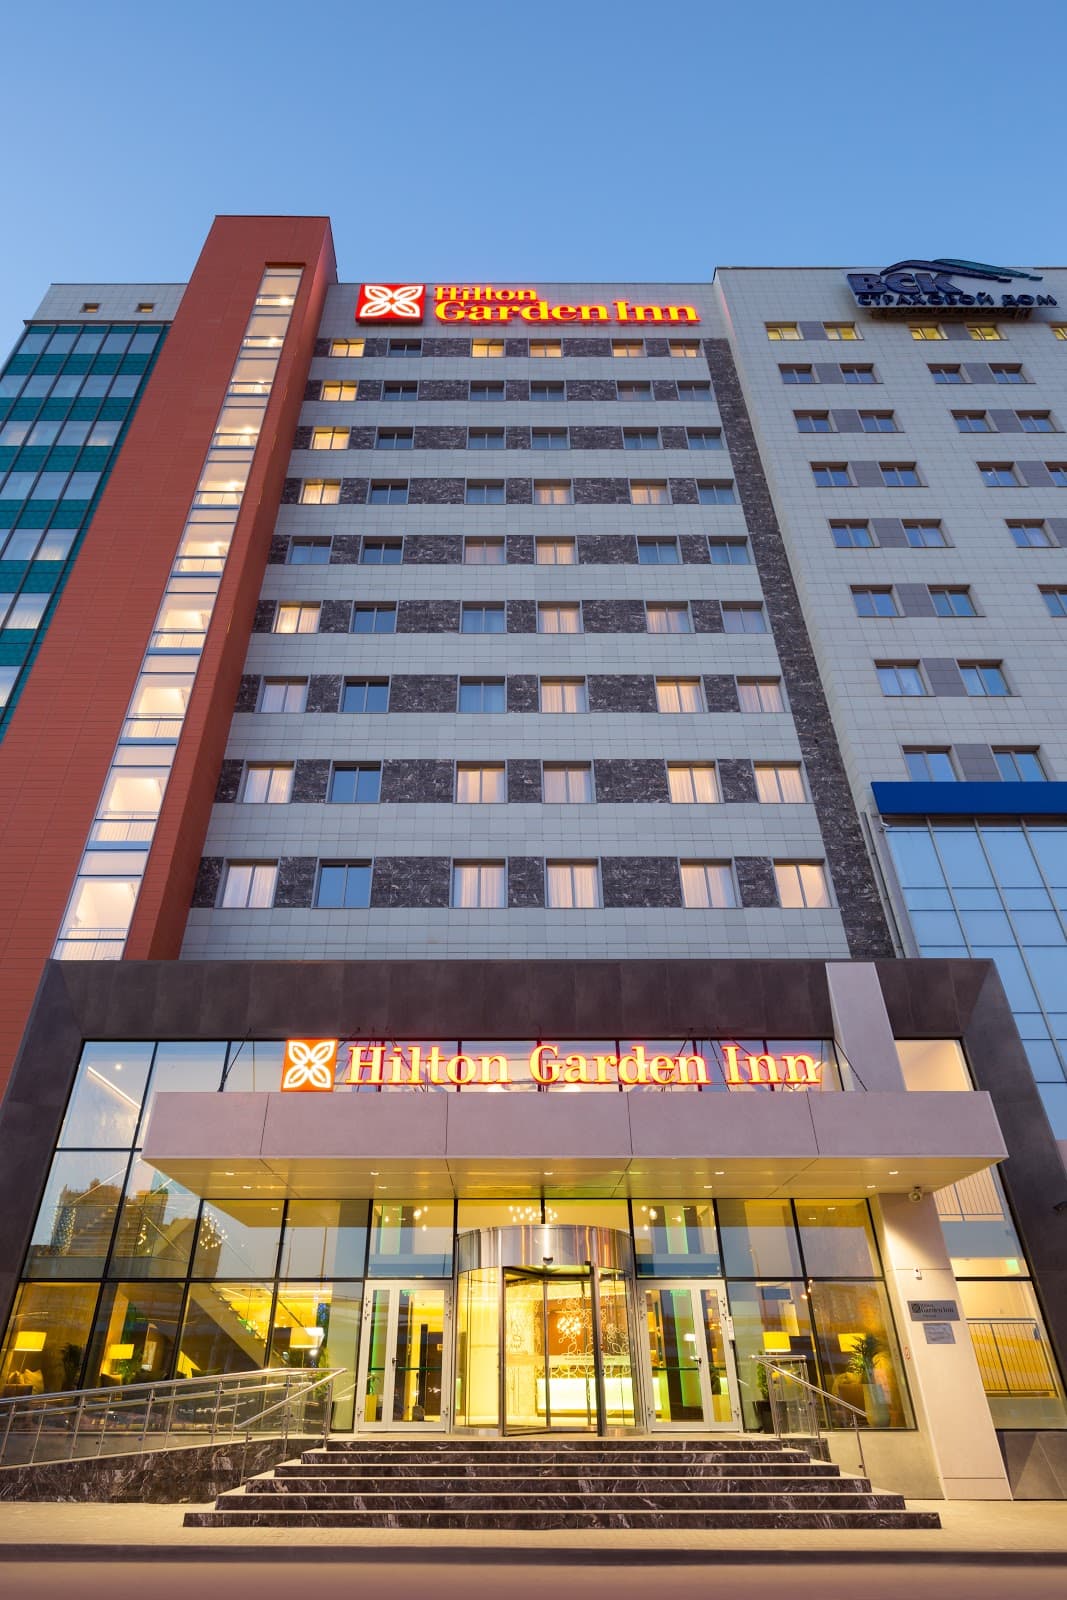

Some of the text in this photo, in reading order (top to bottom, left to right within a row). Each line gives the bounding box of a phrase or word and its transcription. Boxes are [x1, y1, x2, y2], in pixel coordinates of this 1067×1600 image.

[434, 285, 538, 302] Hilton
[847, 273, 963, 295] ВСК
[857, 291, 1058, 307] СТРАХОВОЙ ДОМ
[434, 300, 700, 325] Garden Inn
[346, 1044, 823, 1086] Hilton Garden Inn
